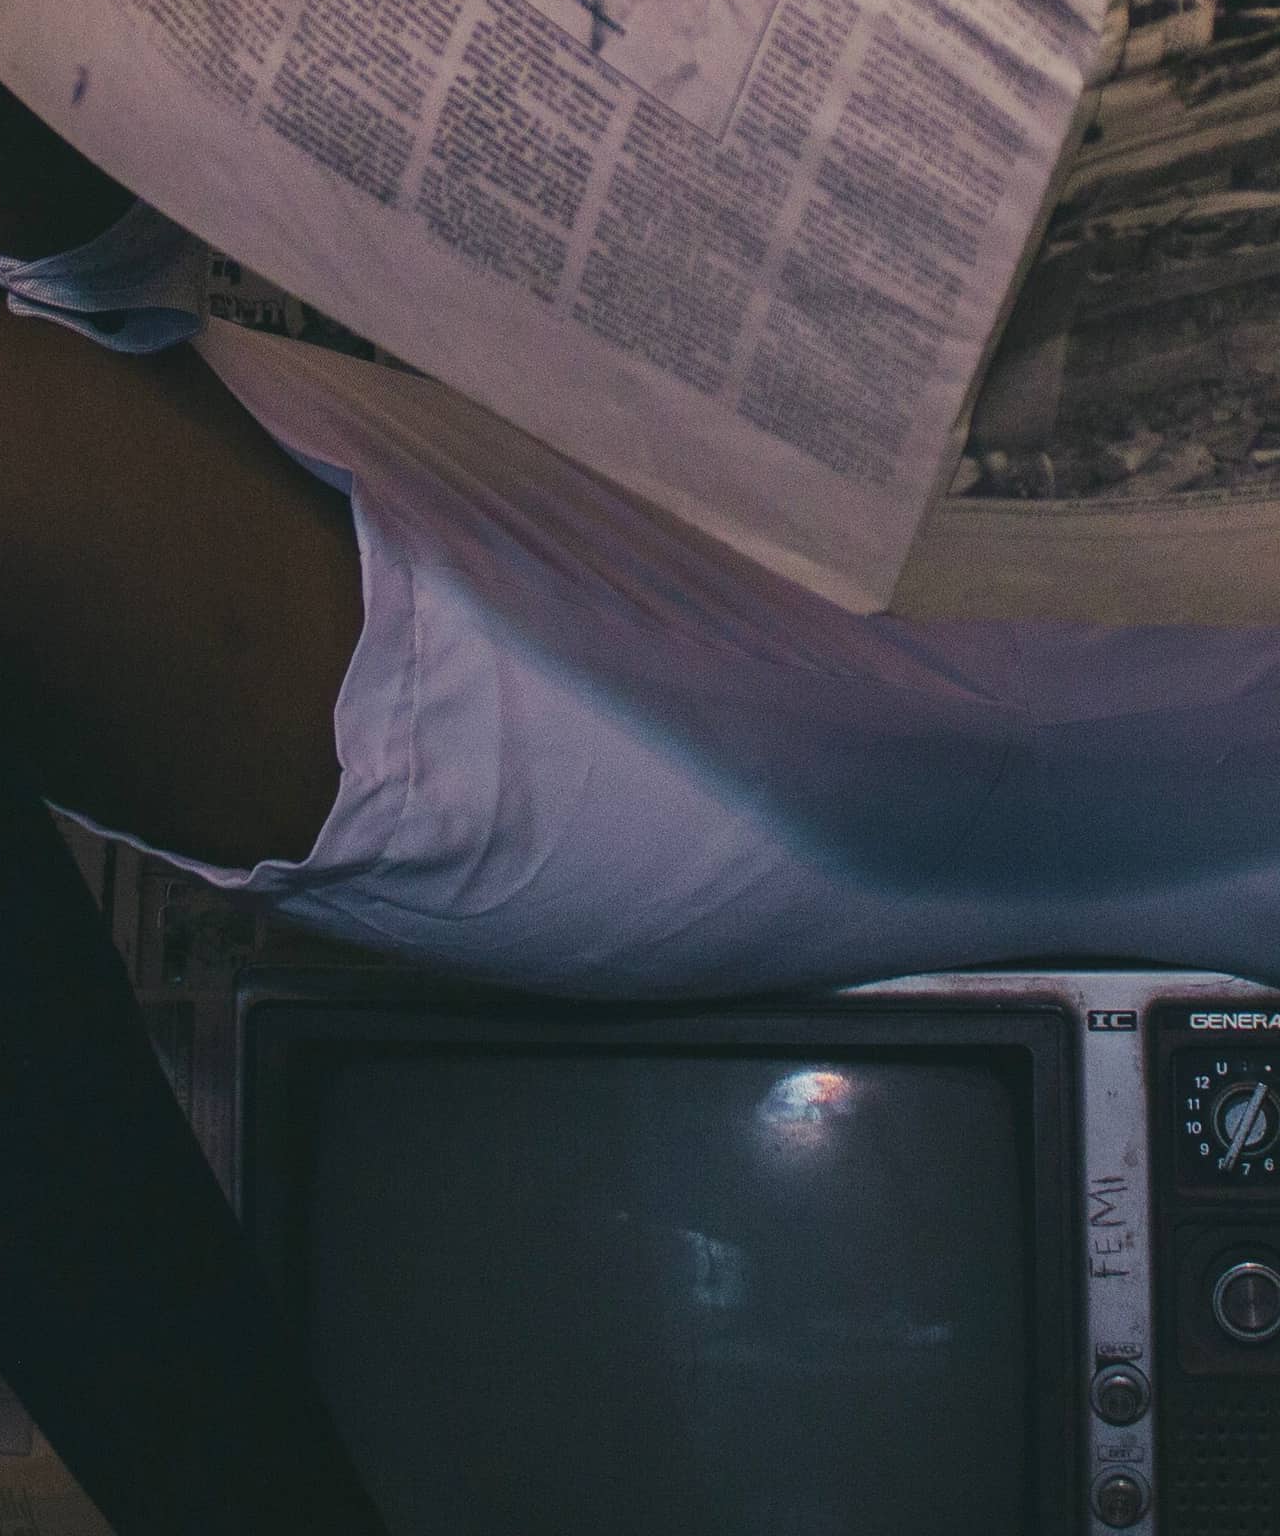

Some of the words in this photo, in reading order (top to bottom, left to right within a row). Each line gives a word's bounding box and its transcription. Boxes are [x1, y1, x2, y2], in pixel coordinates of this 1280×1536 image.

[1092, 1013, 1133, 1029] IC
[1216, 1061, 1228, 1075] U
[1194, 1075, 1211, 1090] 12
[1186, 1098, 1201, 1111] 11
[1185, 1121, 1203, 1135] 10
[1199, 1143, 1210, 1156] 9
[1242, 1163, 1252, 1176] 7
[1263, 1158, 1275, 1173] 6
